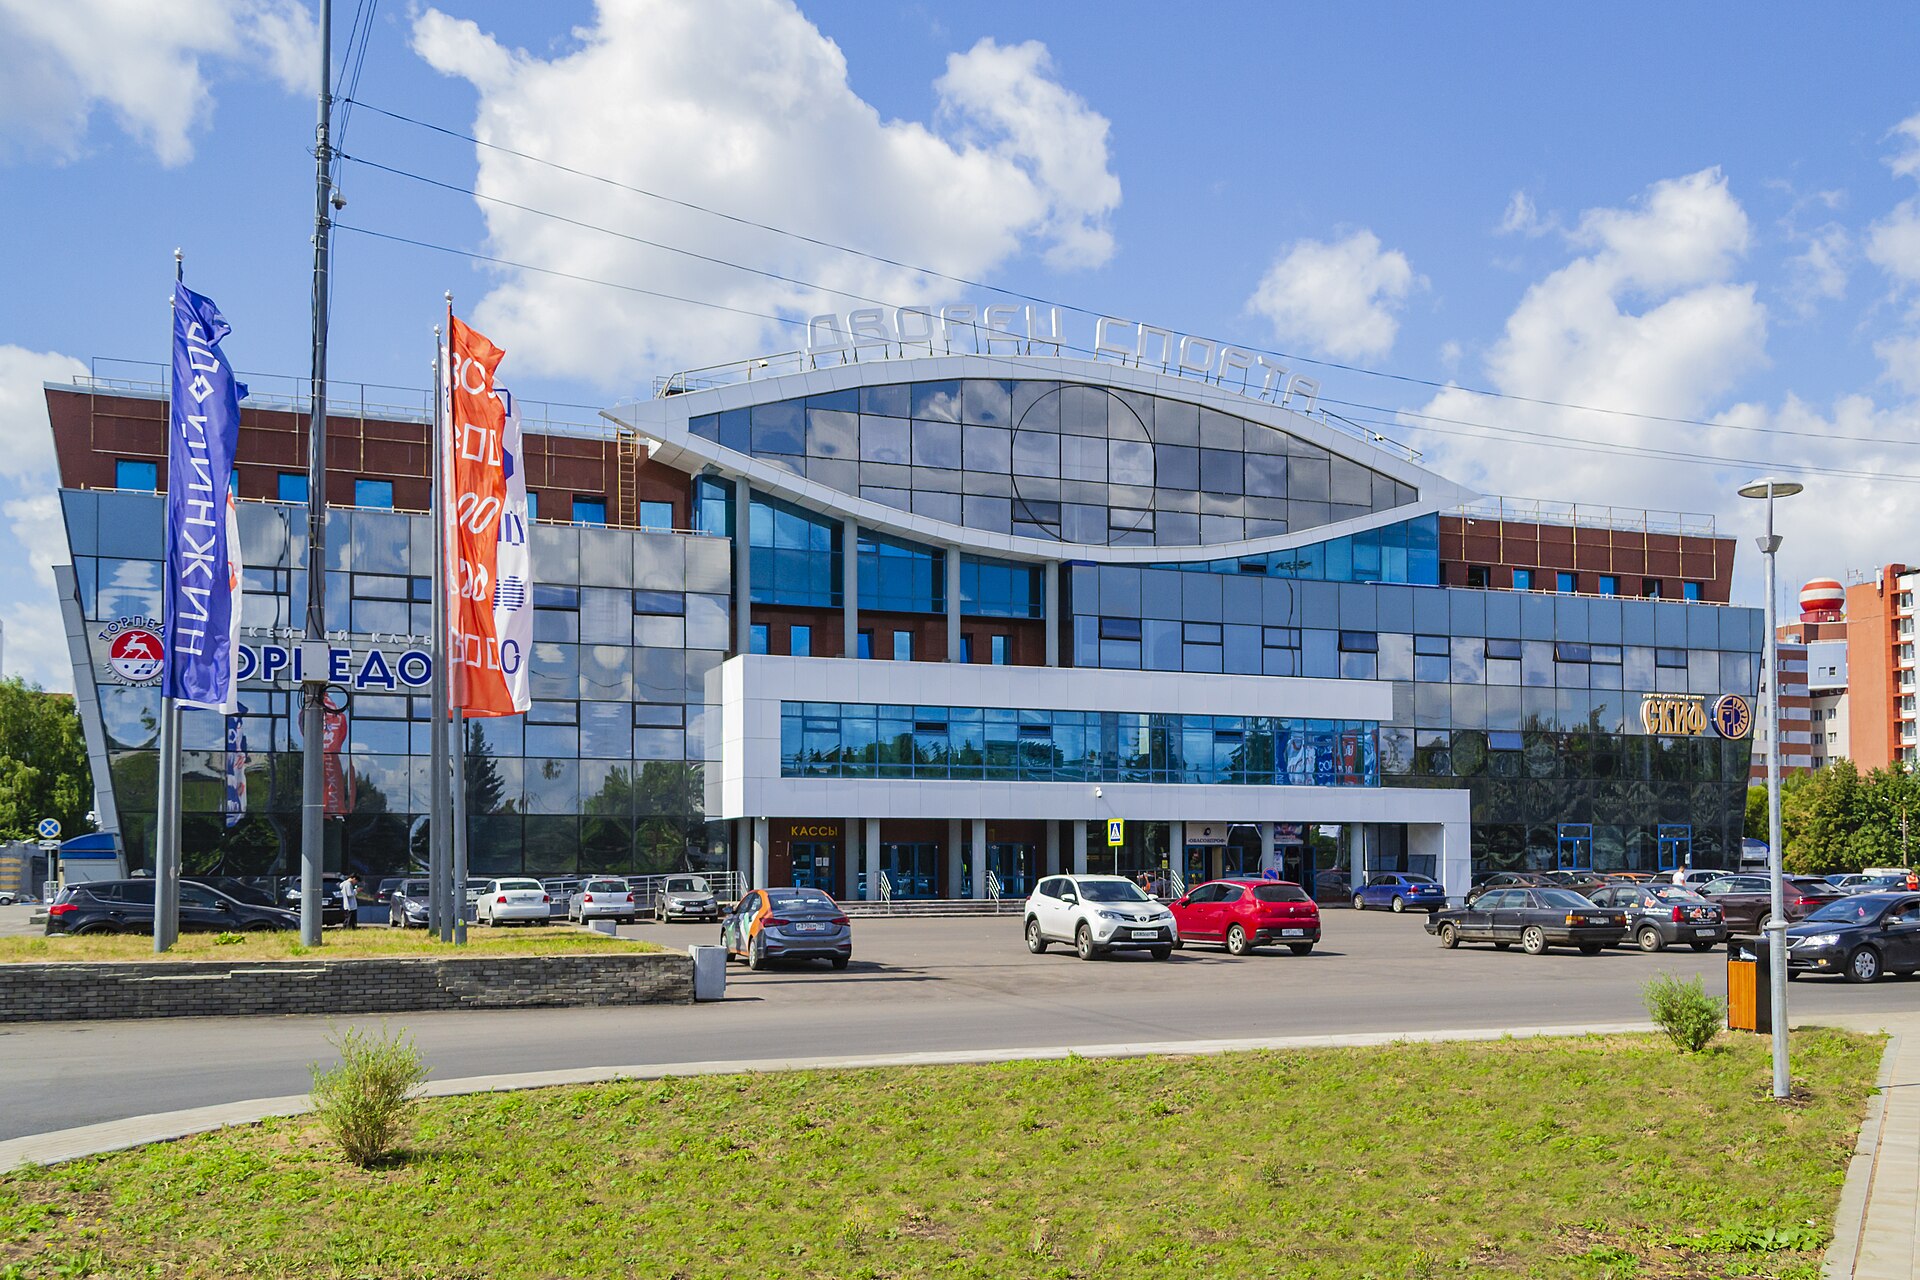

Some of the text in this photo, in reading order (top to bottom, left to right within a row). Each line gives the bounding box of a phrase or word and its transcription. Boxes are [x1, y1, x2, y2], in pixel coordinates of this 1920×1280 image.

[805, 303, 1321, 413] ДВОРЕЦ СПОРТА
[174, 414, 216, 656] НИЖНИЙ
[1639, 699, 1708, 736] СКИФ
[791, 826, 838, 836] КАССЫ
